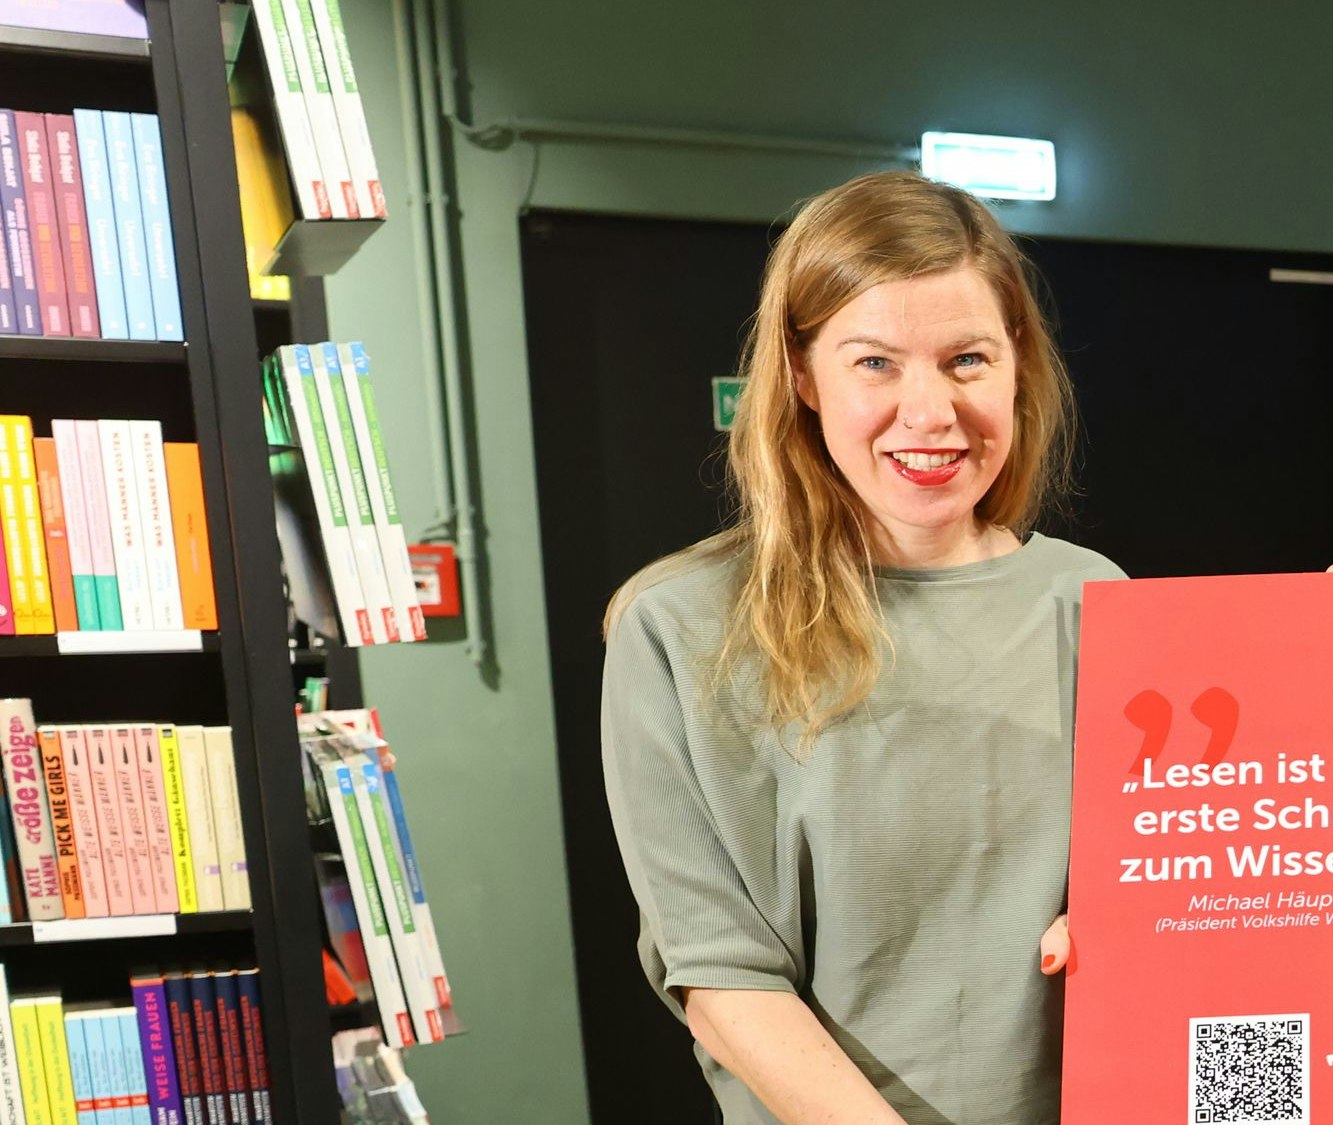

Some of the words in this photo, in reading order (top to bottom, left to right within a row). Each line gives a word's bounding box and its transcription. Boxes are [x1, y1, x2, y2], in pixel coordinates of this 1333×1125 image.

[46, 755, 65, 795] GIRLS
[1278, 753, 1325, 783] ist
[53, 800, 68, 823] ME
[1134, 802, 1239, 835] erste
[56, 824, 74, 857] PICK
[25, 868, 43, 898] KATE
[40, 855, 59, 897] MANNE
[1119, 856, 1212, 883] zum
[1188, 894, 1270, 912] Michael
[1155, 916, 1236, 933] (Präsident
[1242, 912, 1320, 928] Volkshilfe
[145, 991, 162, 1051] FRAUEN
[151, 1055, 170, 1101] WEISE
